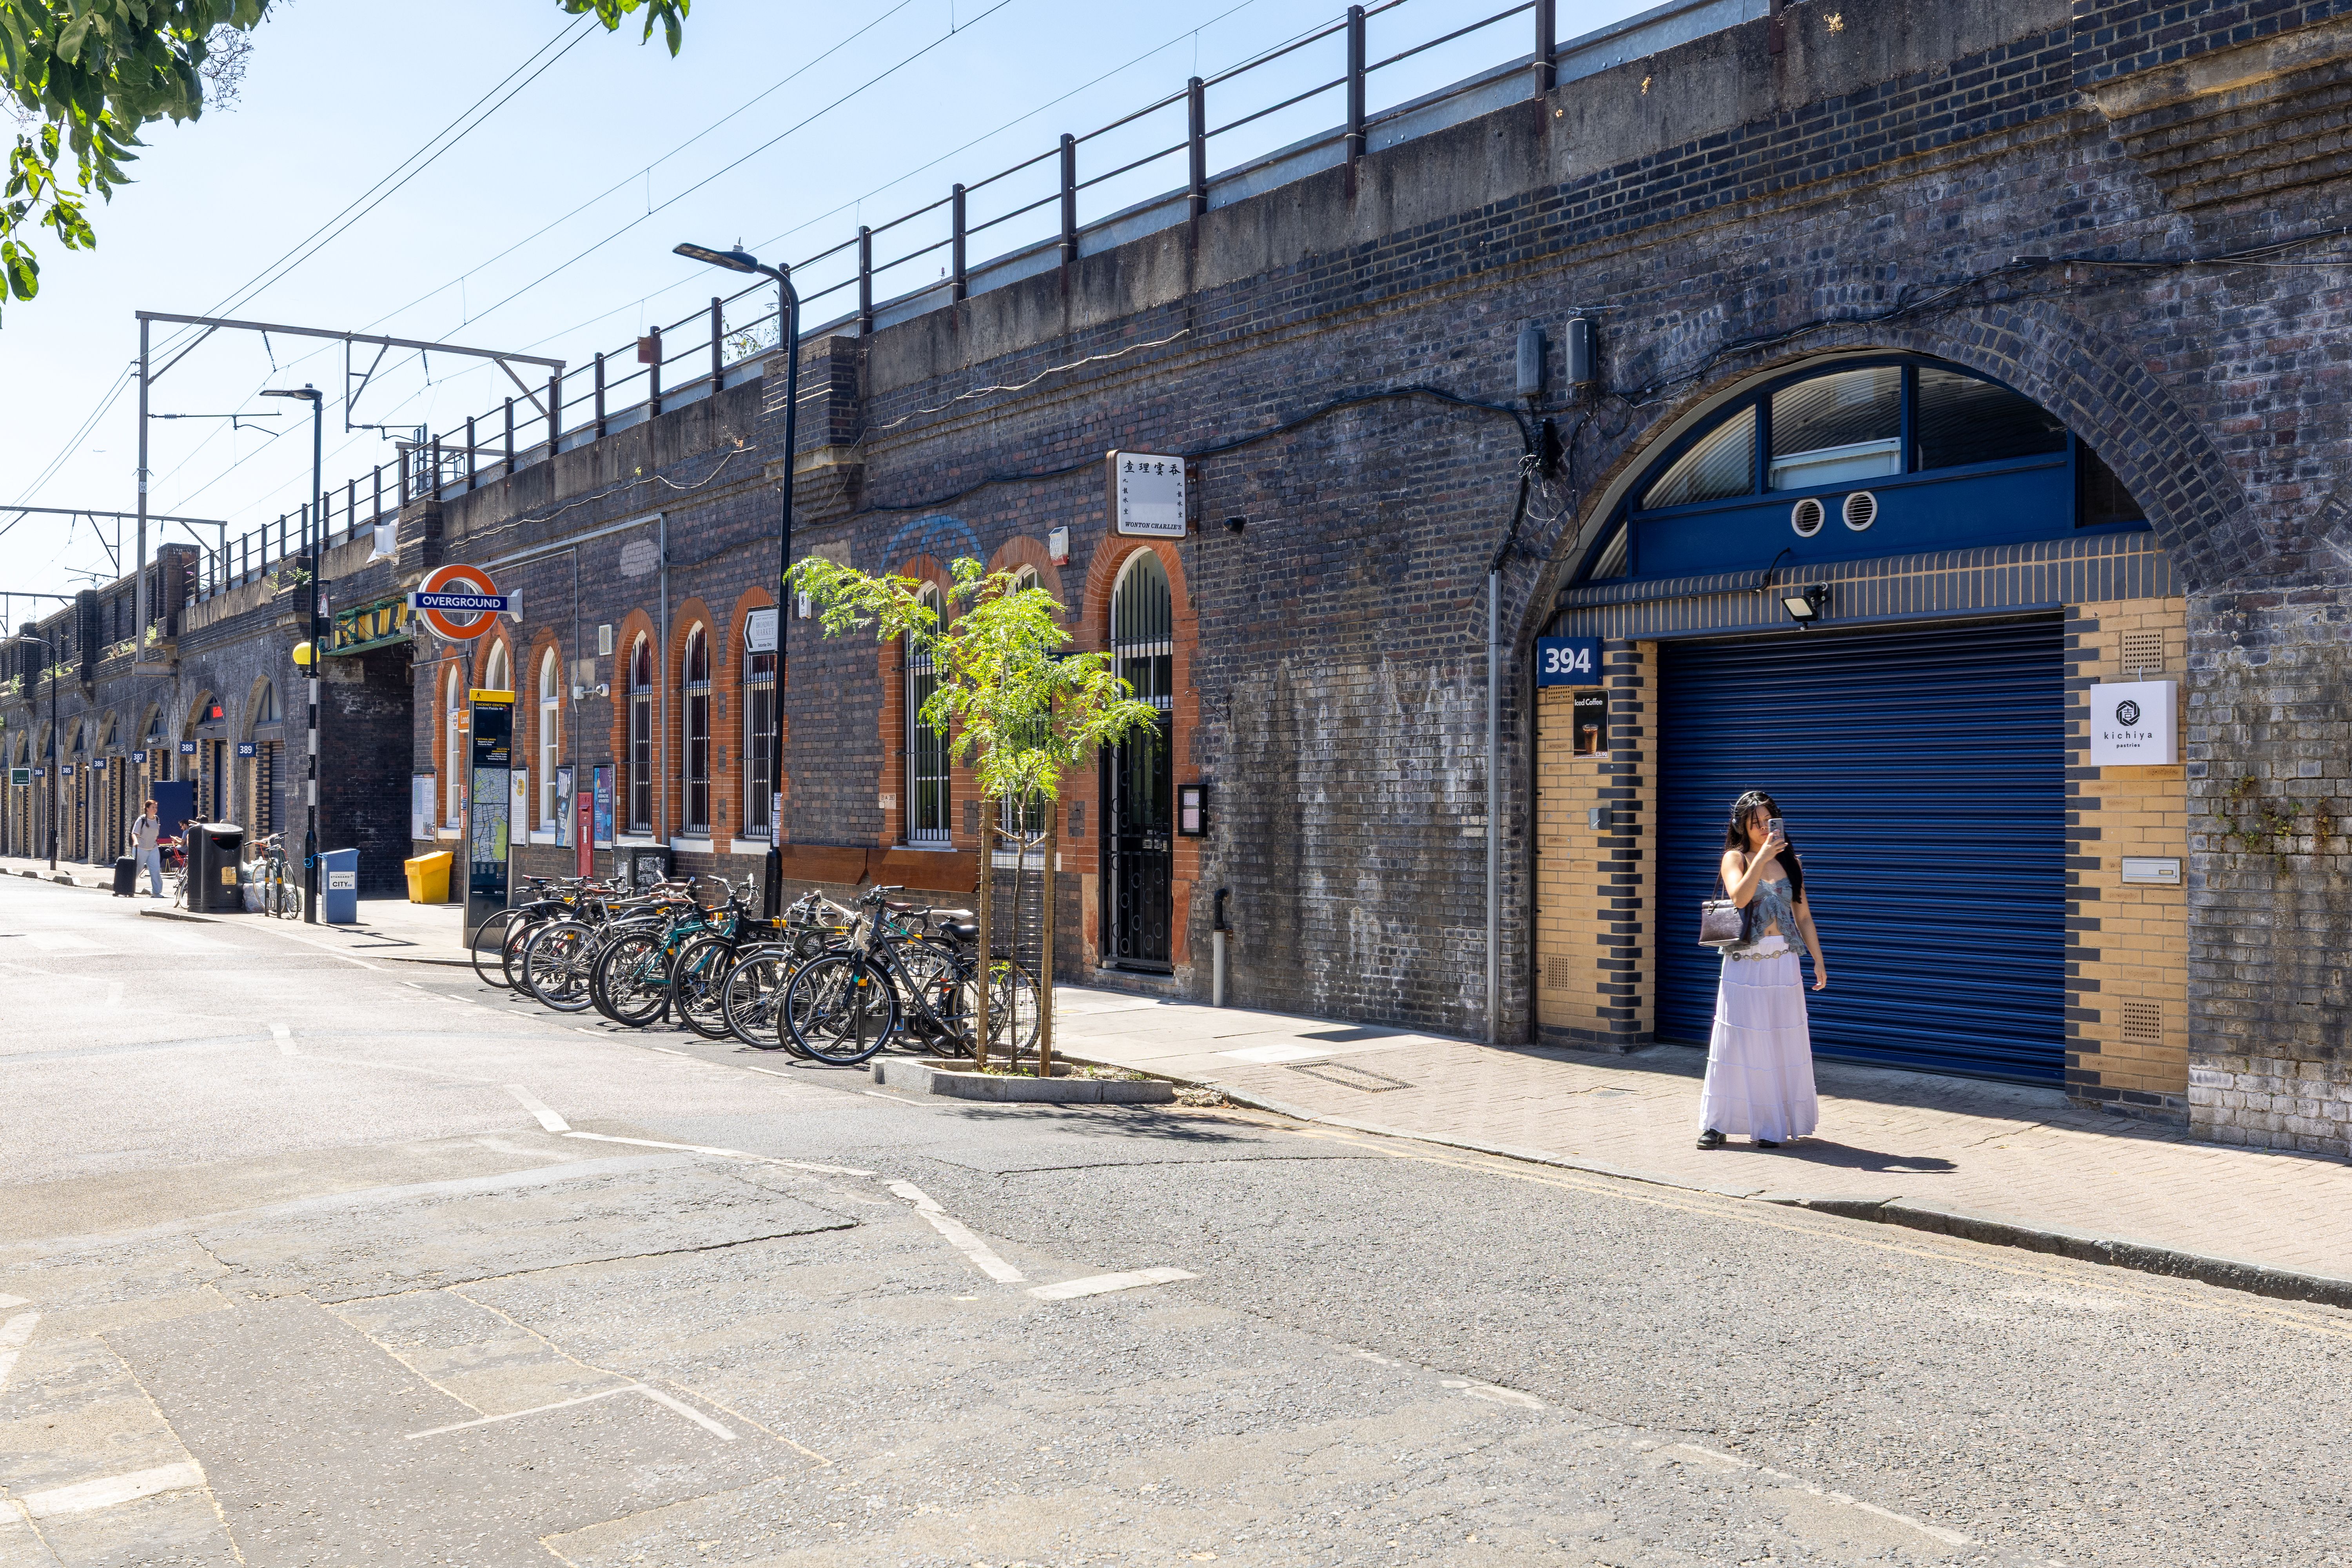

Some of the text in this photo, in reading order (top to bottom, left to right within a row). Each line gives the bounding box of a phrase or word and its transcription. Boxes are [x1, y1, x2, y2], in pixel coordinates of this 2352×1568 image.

[1123, 460, 1181, 476] 查理雲吞
[423, 596, 501, 608] OVERGROUND
[756, 628, 774, 636] MARKET
[1545, 648, 1591, 673] 394
[2104, 731, 2152, 740] kichiya
[240, 746, 252, 754] 389
